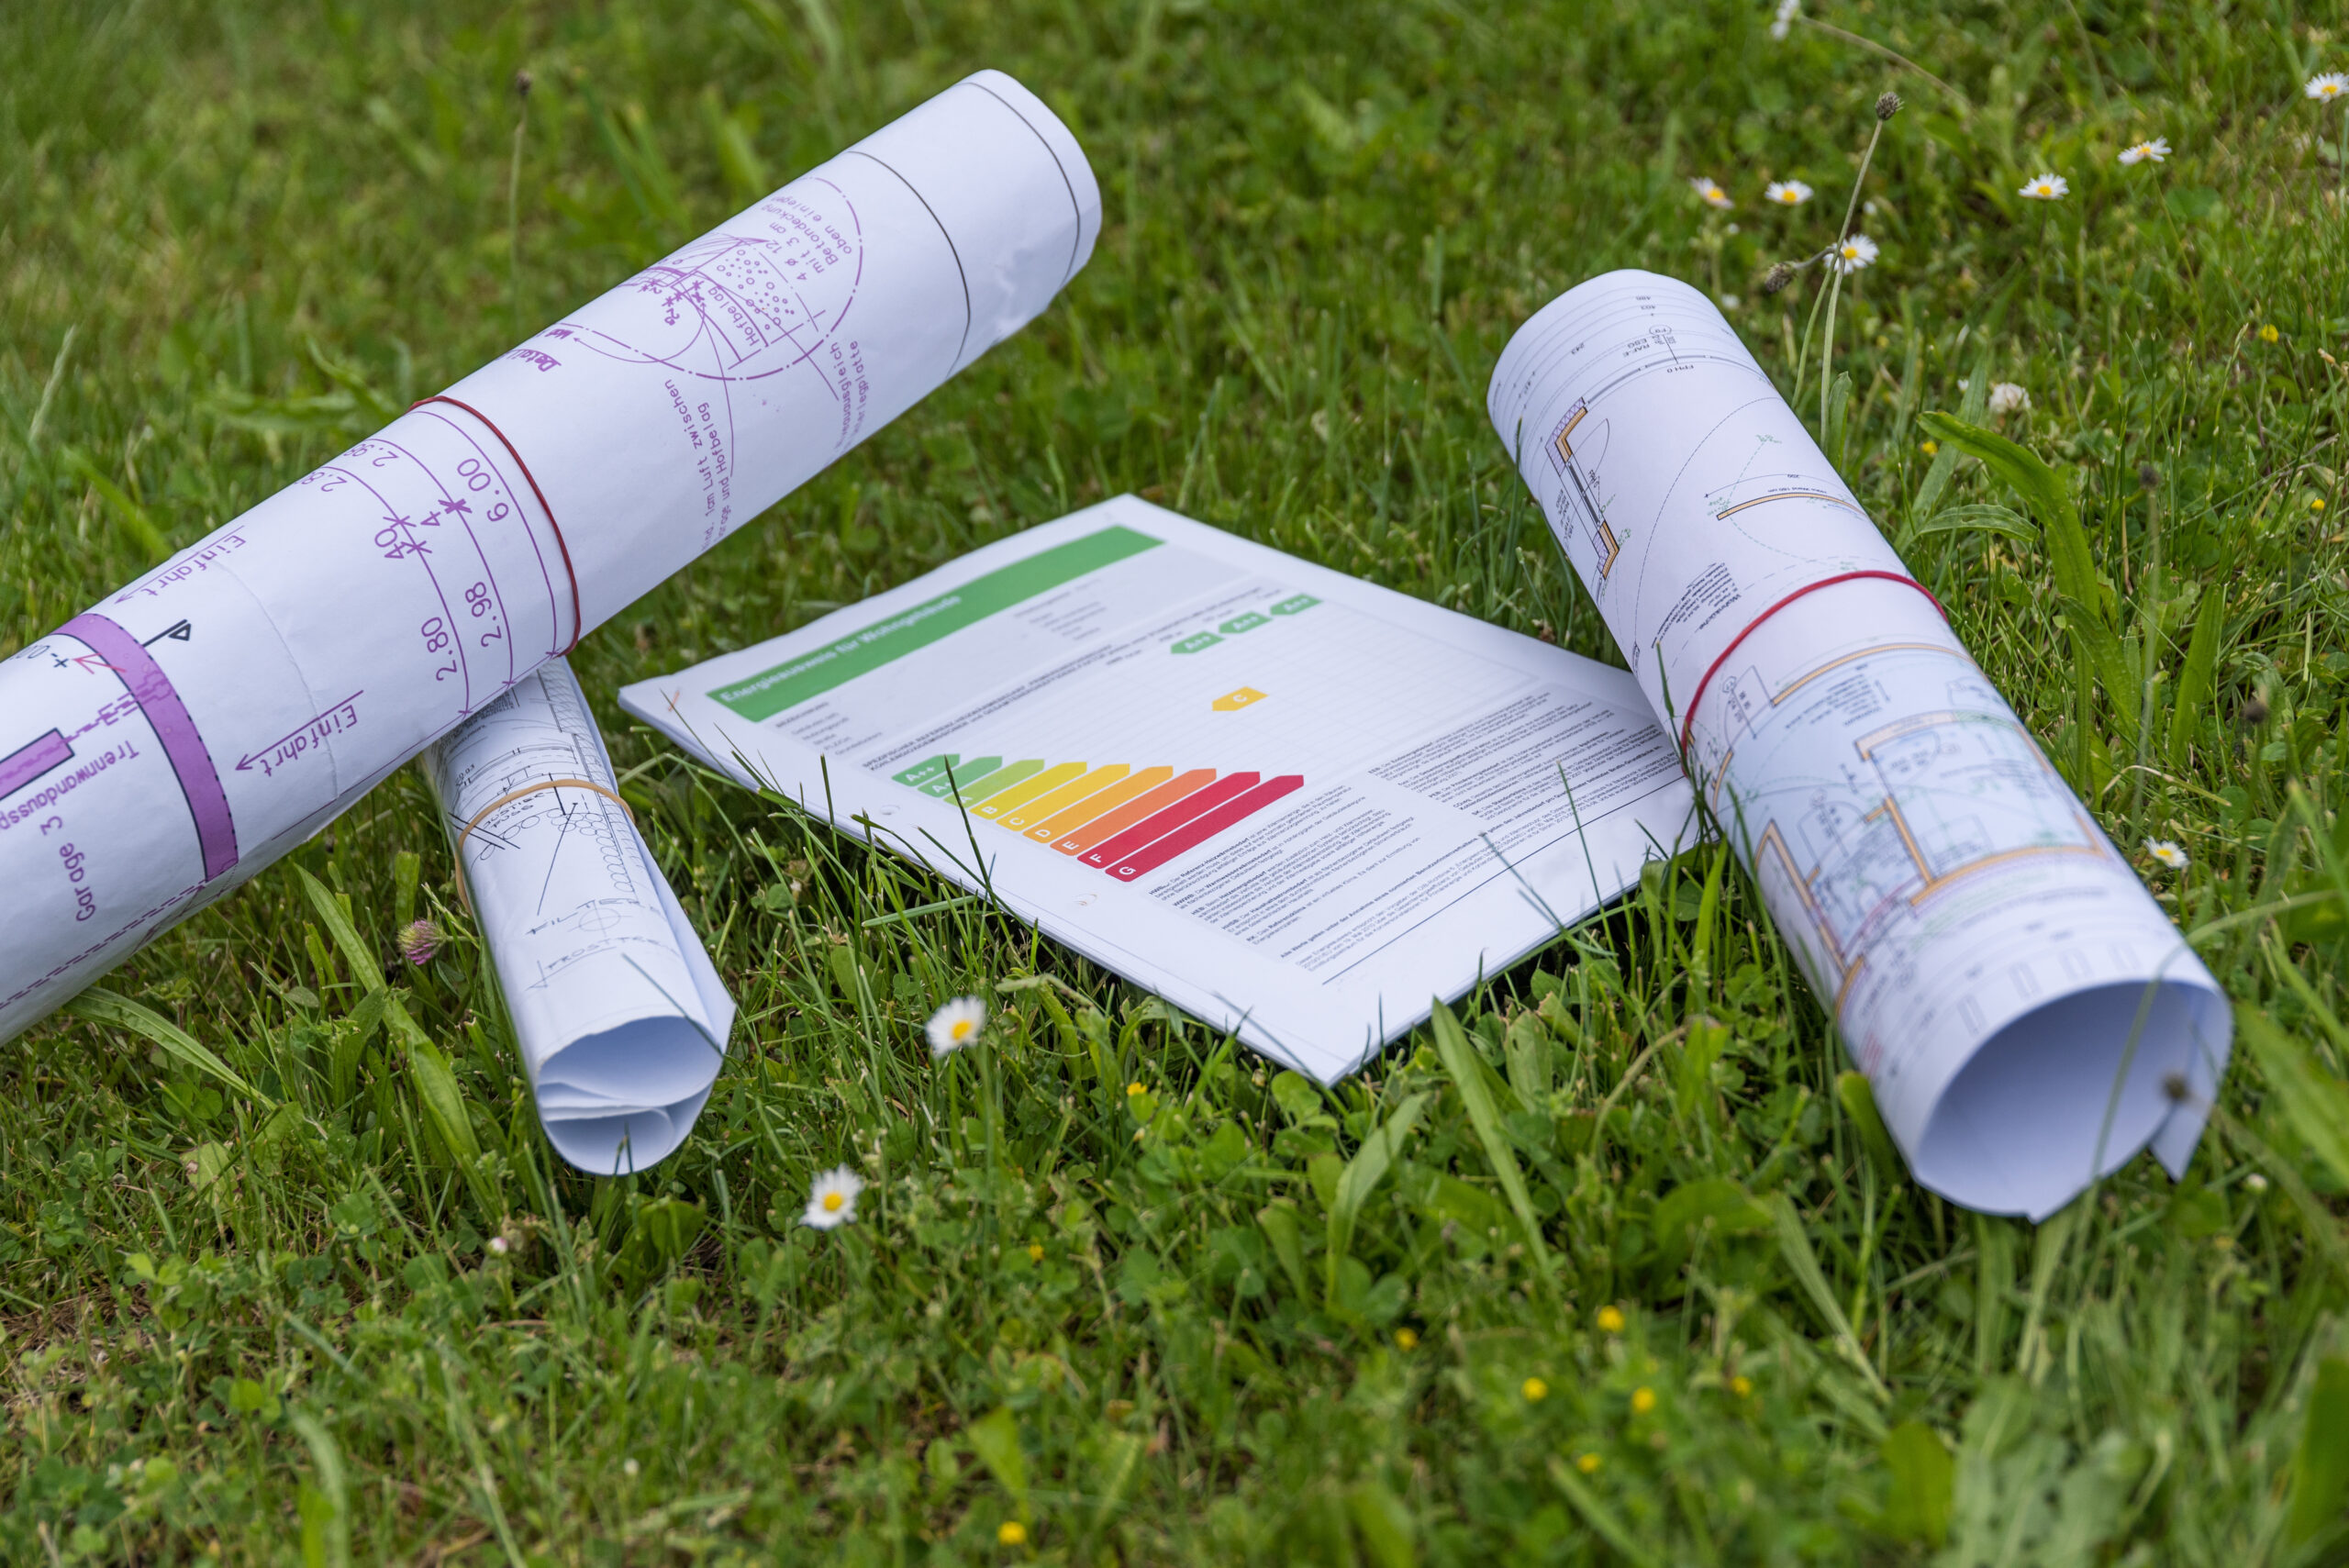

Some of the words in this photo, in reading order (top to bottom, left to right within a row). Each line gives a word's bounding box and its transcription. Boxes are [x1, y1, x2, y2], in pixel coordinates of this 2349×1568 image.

[825, 225, 852, 254] oben
[800, 250, 825, 273] mit
[707, 286, 760, 347] Hofbelag
[664, 379, 703, 450] zwischen
[697, 402, 727, 474] Hofbelag
[696, 456, 714, 491] Luft
[457, 458, 509, 522] 6.00
[420, 510, 440, 526] 4
[141, 535, 246, 595] Einfahrt
[465, 582, 501, 648] 2.98
[421, 617, 457, 681] 2.80
[260, 705, 357, 777] Einfahrt
[906, 765, 935, 782] A++
[981, 806, 997, 815] B
[1009, 817, 1025, 826] C
[39, 816, 62, 836] 3
[1034, 828, 1051, 838] D
[1063, 840, 1079, 851] E
[1089, 853, 1103, 863] F
[59, 842, 96, 922] Garage
[1119, 866, 1137, 876] G
